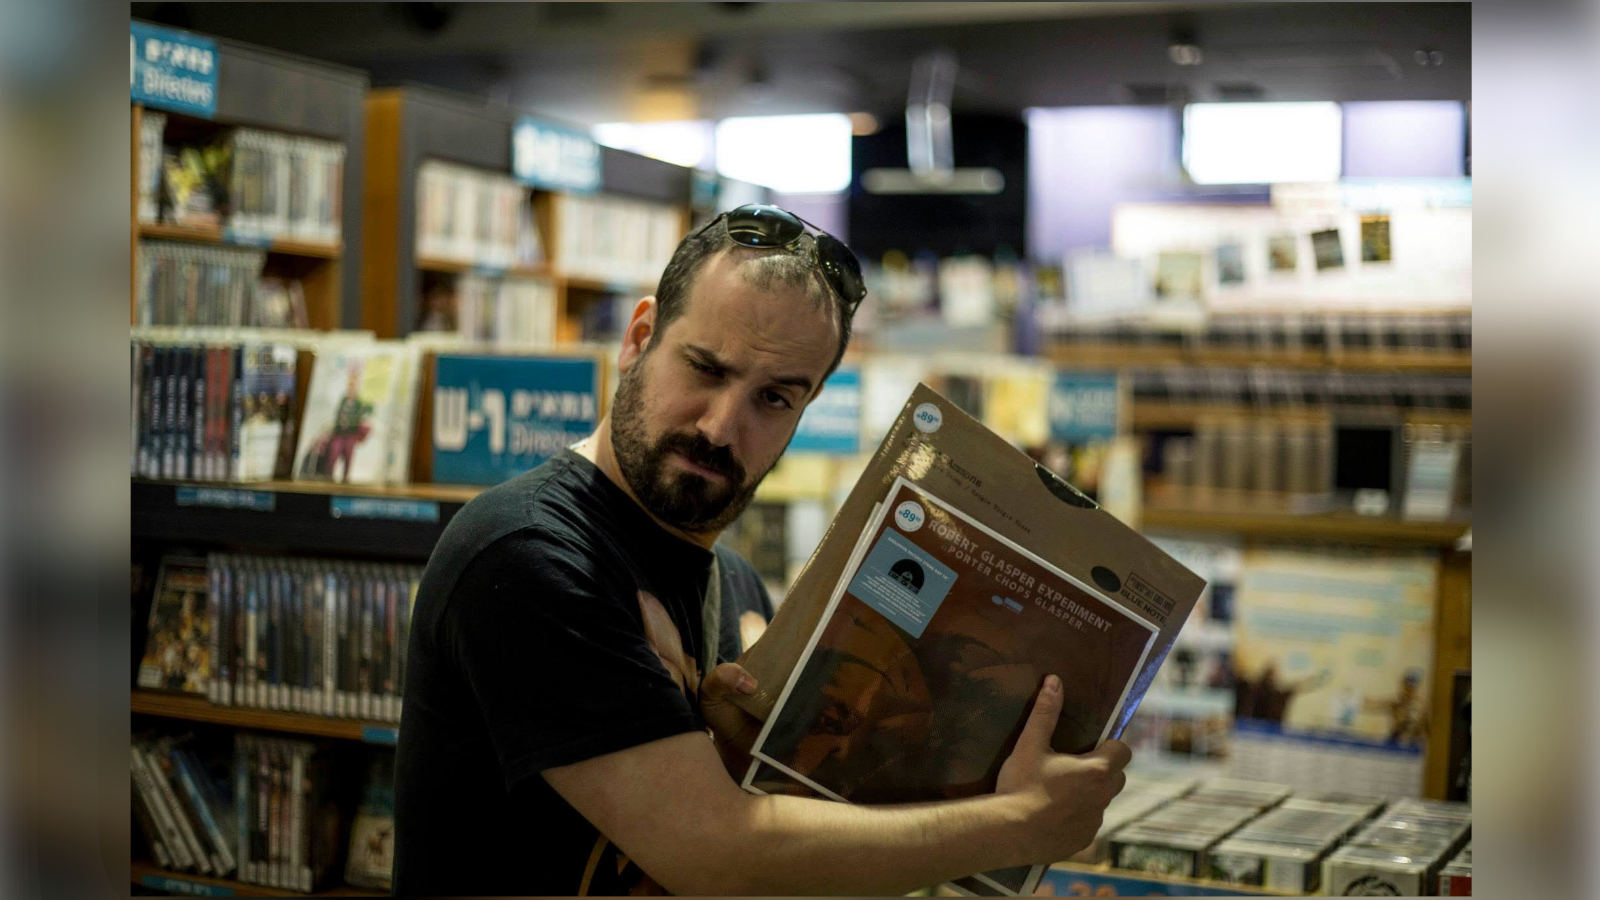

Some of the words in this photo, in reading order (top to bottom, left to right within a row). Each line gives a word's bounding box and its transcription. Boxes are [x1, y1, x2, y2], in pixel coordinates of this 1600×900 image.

[928, 520, 978, 554] ROBERT
[980, 550, 1036, 589] GLASPER
[1037, 583, 1112, 633] EXPERIMENT
[947, 545, 992, 576] PORTER
[995, 574, 1032, 599] CHOPS
[1034, 596, 1083, 629] GLASPER
[1120, 588, 1142, 608] BLUE
[1143, 603, 1167, 623] NOTE
